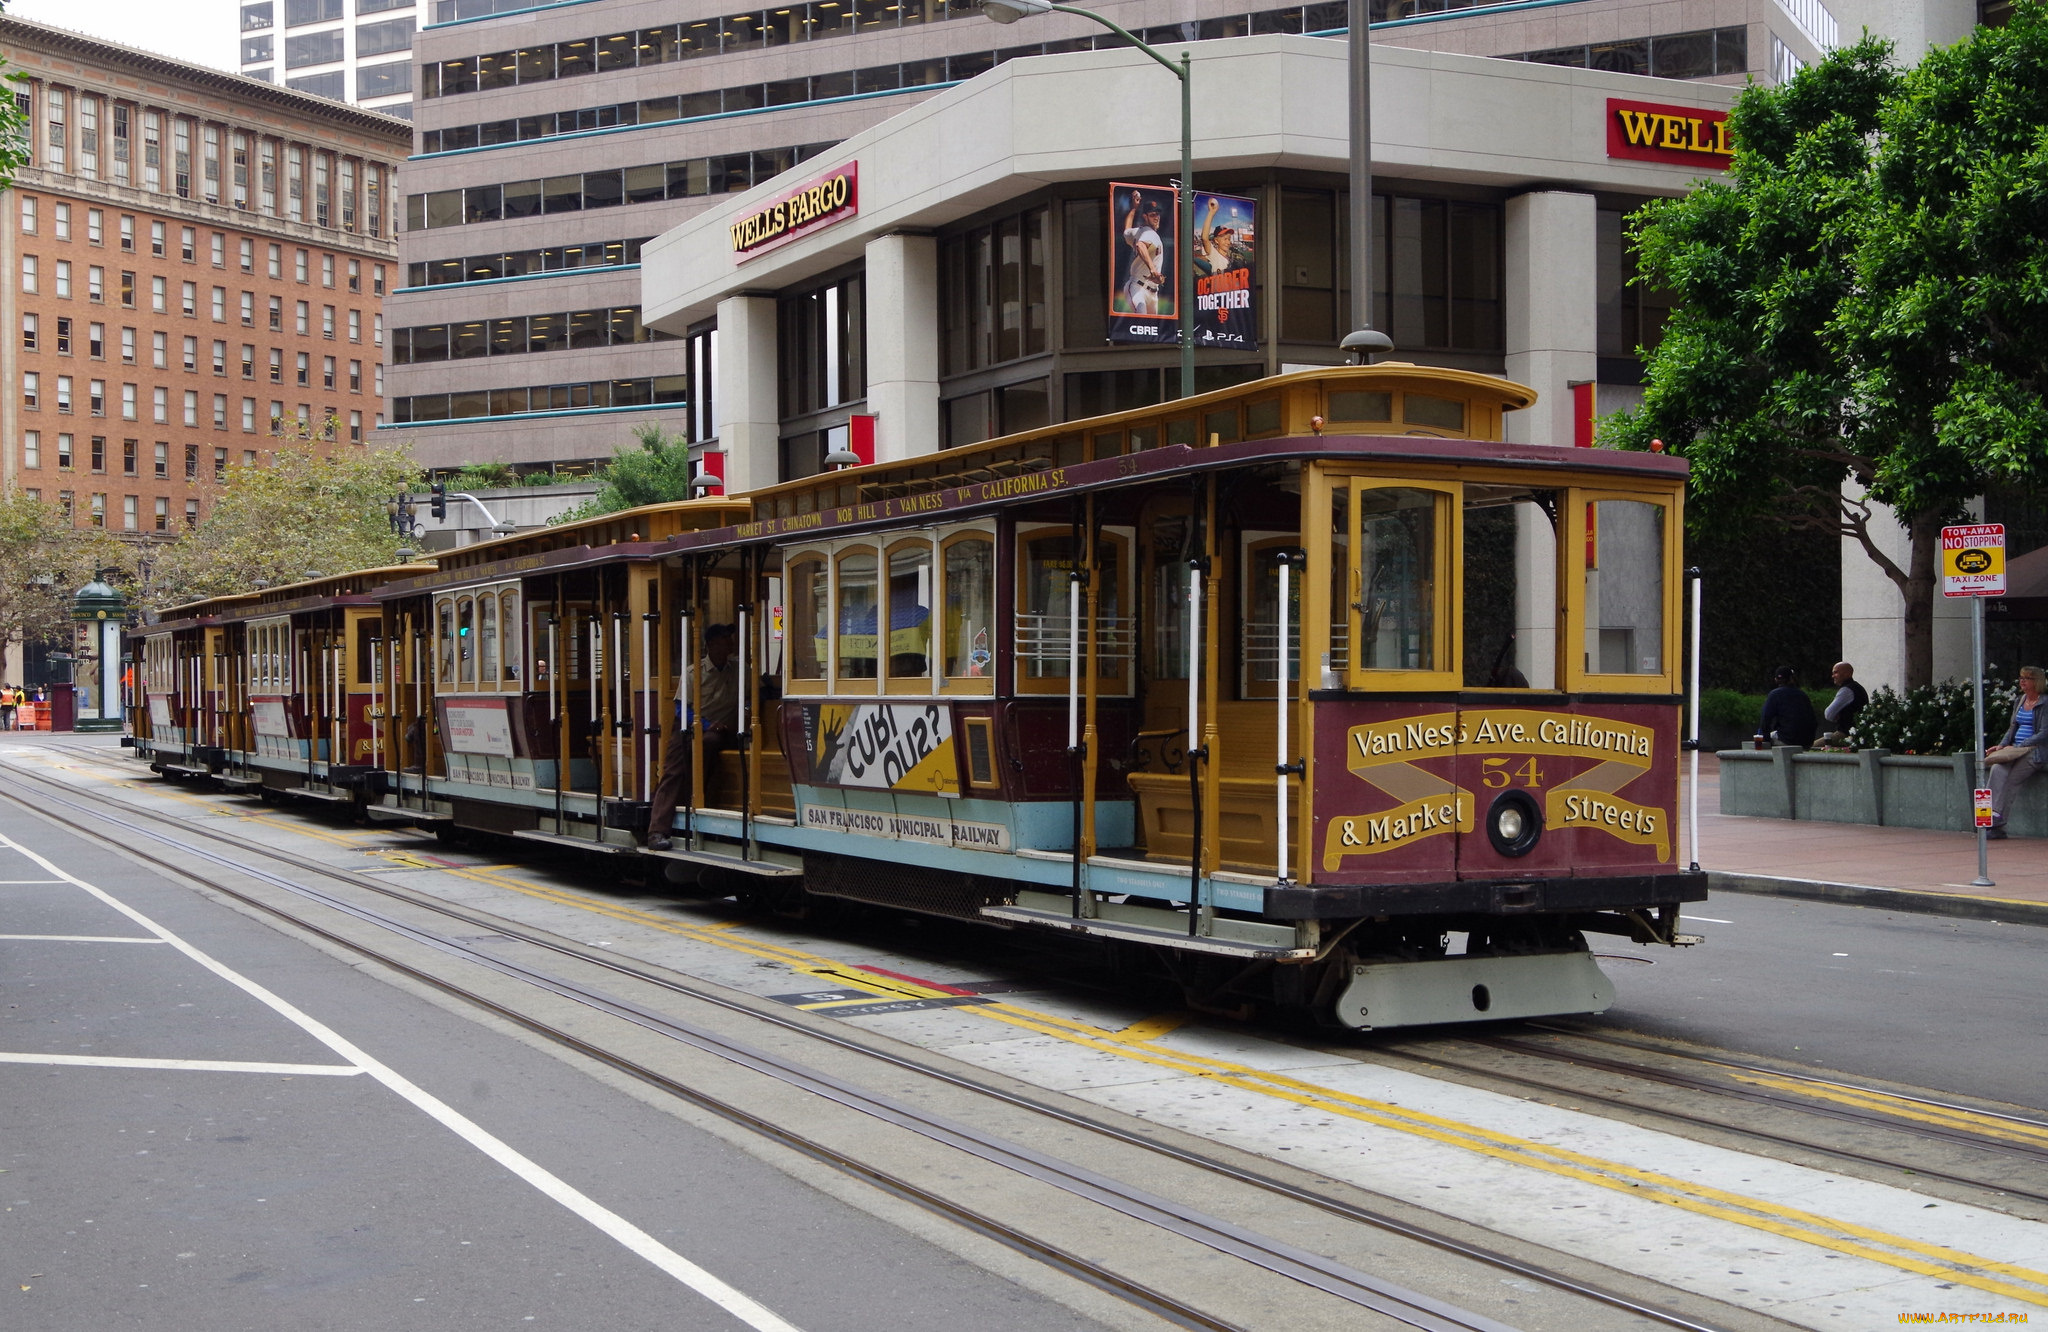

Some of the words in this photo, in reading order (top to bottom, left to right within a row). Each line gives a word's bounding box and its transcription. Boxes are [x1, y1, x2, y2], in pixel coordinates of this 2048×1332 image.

[1619, 109, 1736, 155] WELL
[729, 201, 785, 251] WELLS
[788, 174, 848, 228] FARGO
[1197, 267, 1249, 295] OCTOBER
[1197, 289, 1249, 310] TOGETHER
[1129, 325, 1158, 336] CBRE
[1217, 332, 1244, 343] PS4
[1118, 457, 1138, 475] 54
[737, 522, 763, 538] MARKET
[782, 512, 822, 531] CHINATOWN
[837, 507, 853, 524] NOB
[857, 504, 877, 520] HILL
[885, 501, 892, 516] &
[900, 496, 917, 512] VAN
[919, 493, 943, 510] NESS
[957, 488, 972, 503] VIA
[981, 473, 1048, 500] CALIFORNIA
[1051, 469, 1069, 487] ST.
[1945, 537, 1963, 549] NO
[1964, 535, 2003, 548] STOPPING
[1947, 526, 1998, 537] TOW-AWAY
[1974, 574, 1997, 582] ZONE
[362, 739, 371, 751] &
[1354, 729, 1403, 757] Van
[1404, 720, 1468, 750] Ness
[1539, 718, 1650, 757] California
[1481, 755, 1544, 788] 54
[808, 808, 828, 825] SAN
[829, 810, 884, 832] FRANCISCO
[890, 817, 944, 839] MUNICIPAL
[951, 823, 1000, 846] RAILWAY
[1341, 820, 1362, 847] &
[1368, 797, 1463, 845] Market
[1564, 795, 1656, 836] Streets
[1117, 876, 1128, 885] TWO
[1151, 880, 1165, 889] ONLY
